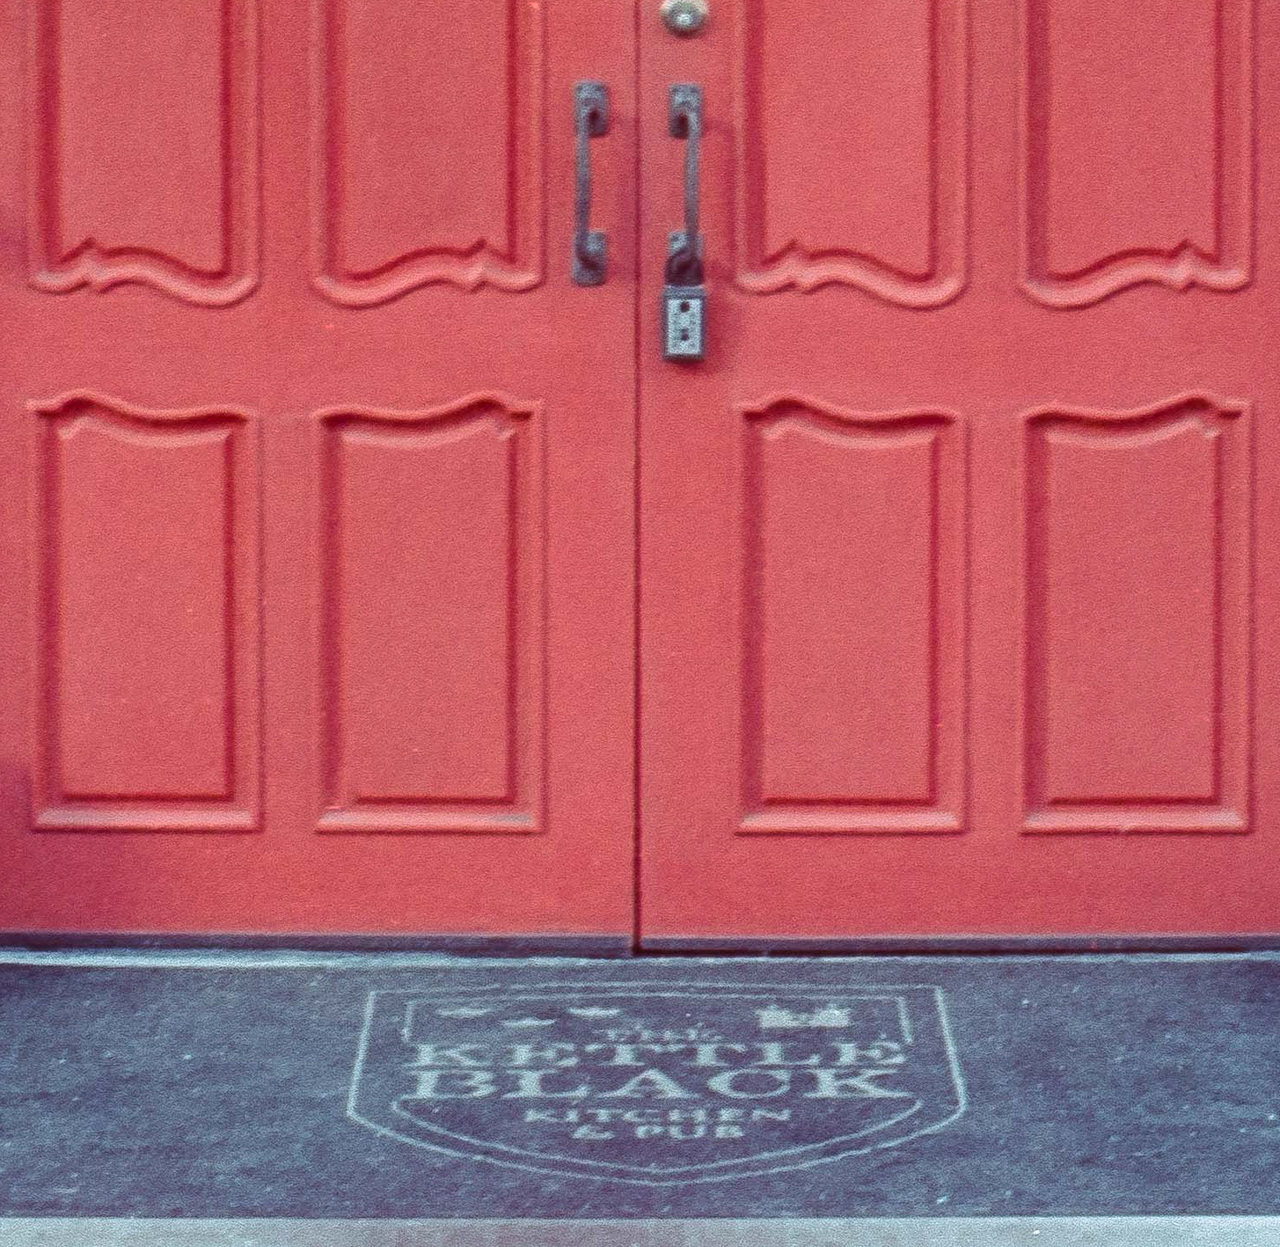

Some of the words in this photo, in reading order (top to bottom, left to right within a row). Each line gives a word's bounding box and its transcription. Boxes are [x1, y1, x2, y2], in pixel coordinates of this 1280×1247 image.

[403, 1040, 908, 1067] KETTLE
[405, 1067, 915, 1100] BLACK
[524, 1107, 793, 1123] KITCHEN
[635, 1124, 746, 1139] PUB
